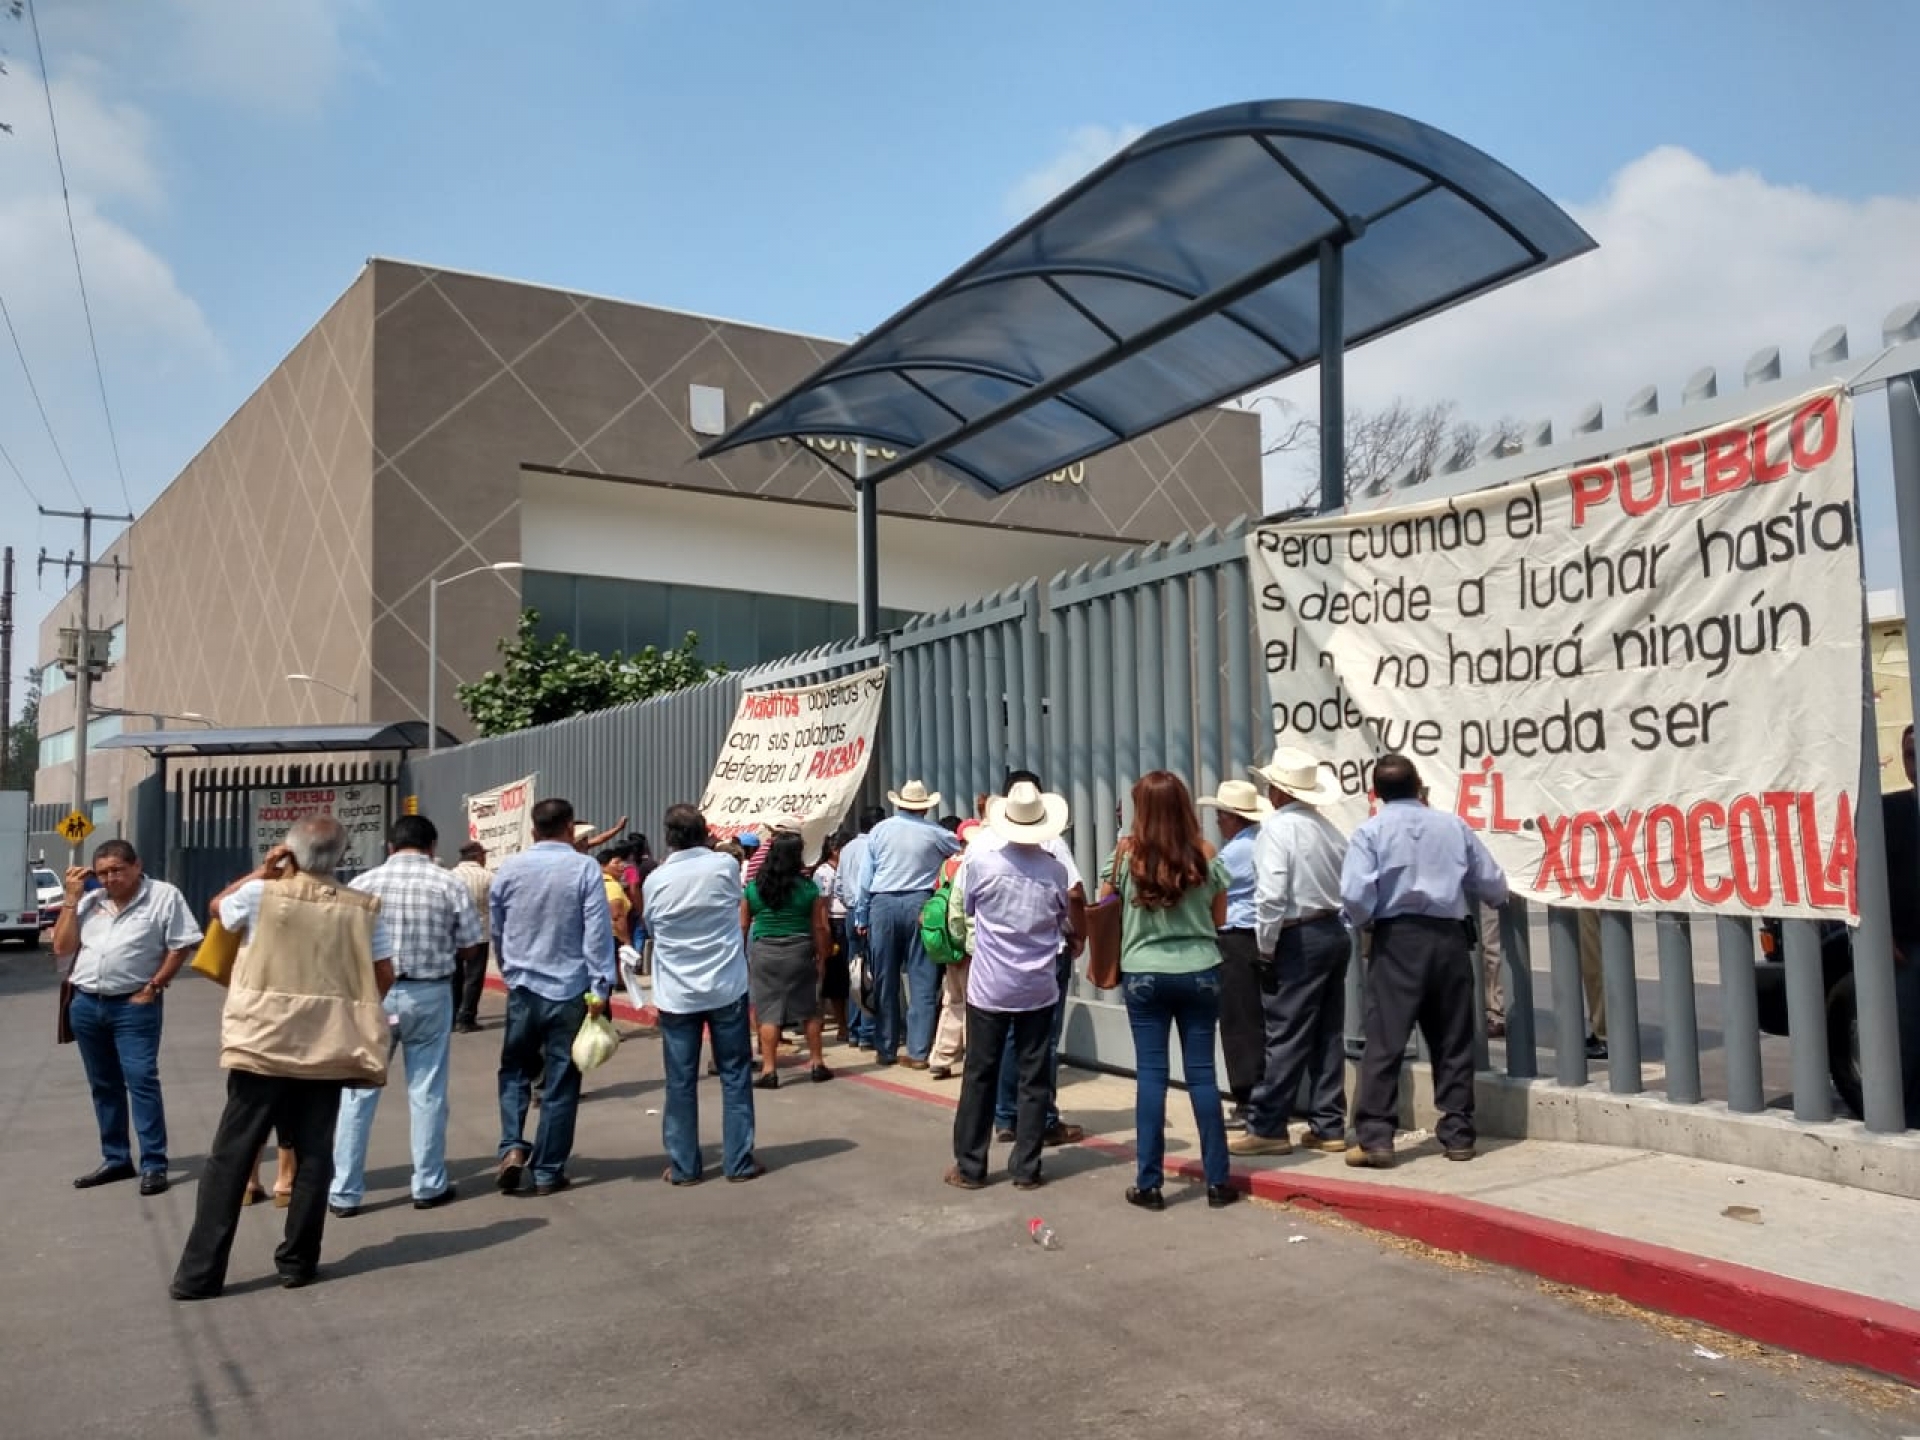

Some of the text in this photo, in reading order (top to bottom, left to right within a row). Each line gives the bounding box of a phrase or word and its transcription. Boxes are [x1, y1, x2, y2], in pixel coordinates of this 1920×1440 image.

[1349, 498, 1486, 562] cuando
[1506, 483, 1542, 539] el
[1568, 395, 1841, 529] PUEBLO
[1299, 575, 1432, 625] decide
[1457, 576, 1486, 618] a
[1520, 543, 1670, 610] luchar
[1698, 492, 1853, 579] hasta
[1265, 626, 1298, 673] el
[1373, 652, 1429, 688] no
[1447, 623, 1585, 686] habrá
[1613, 590, 1812, 679] ningún
[714, 755, 786, 784] defienden
[805, 735, 866, 782] PUEBLO
[728, 722, 847, 757] con sus palabras
[1460, 698, 1606, 769] pueda
[1630, 700, 1729, 751] ser
[284, 789, 336, 804] PUEBLO
[1534, 790, 1858, 916] XOXOCOTLA
